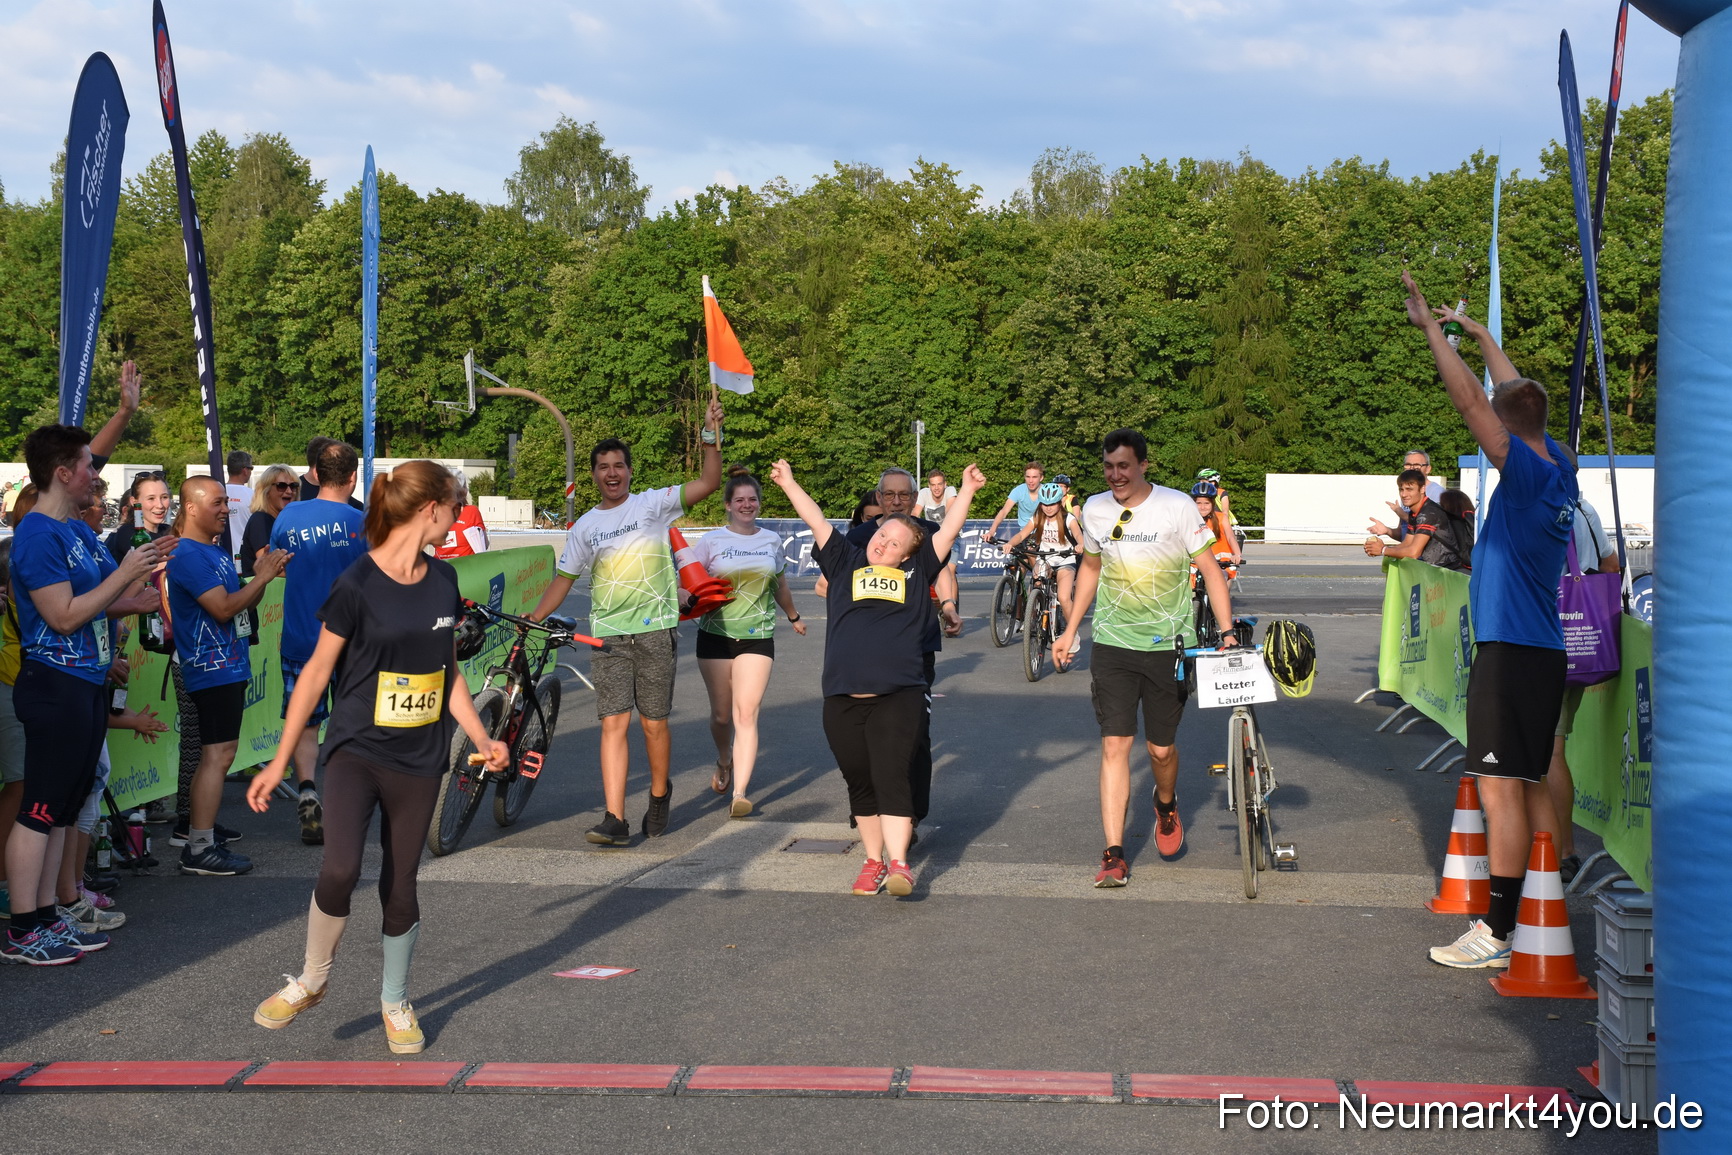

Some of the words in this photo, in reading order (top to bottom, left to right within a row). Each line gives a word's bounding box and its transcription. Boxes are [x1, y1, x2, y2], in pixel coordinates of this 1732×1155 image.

[86, 99, 108, 209] Fischer
[600, 521, 639, 541] firmenlauf
[860, 578, 898, 591] 1450
[1223, 664, 1254, 673] firmenlauf
[1215, 680, 1256, 690] Letzter
[388, 691, 436, 712] 1446
[1218, 695, 1255, 705] Läufer
